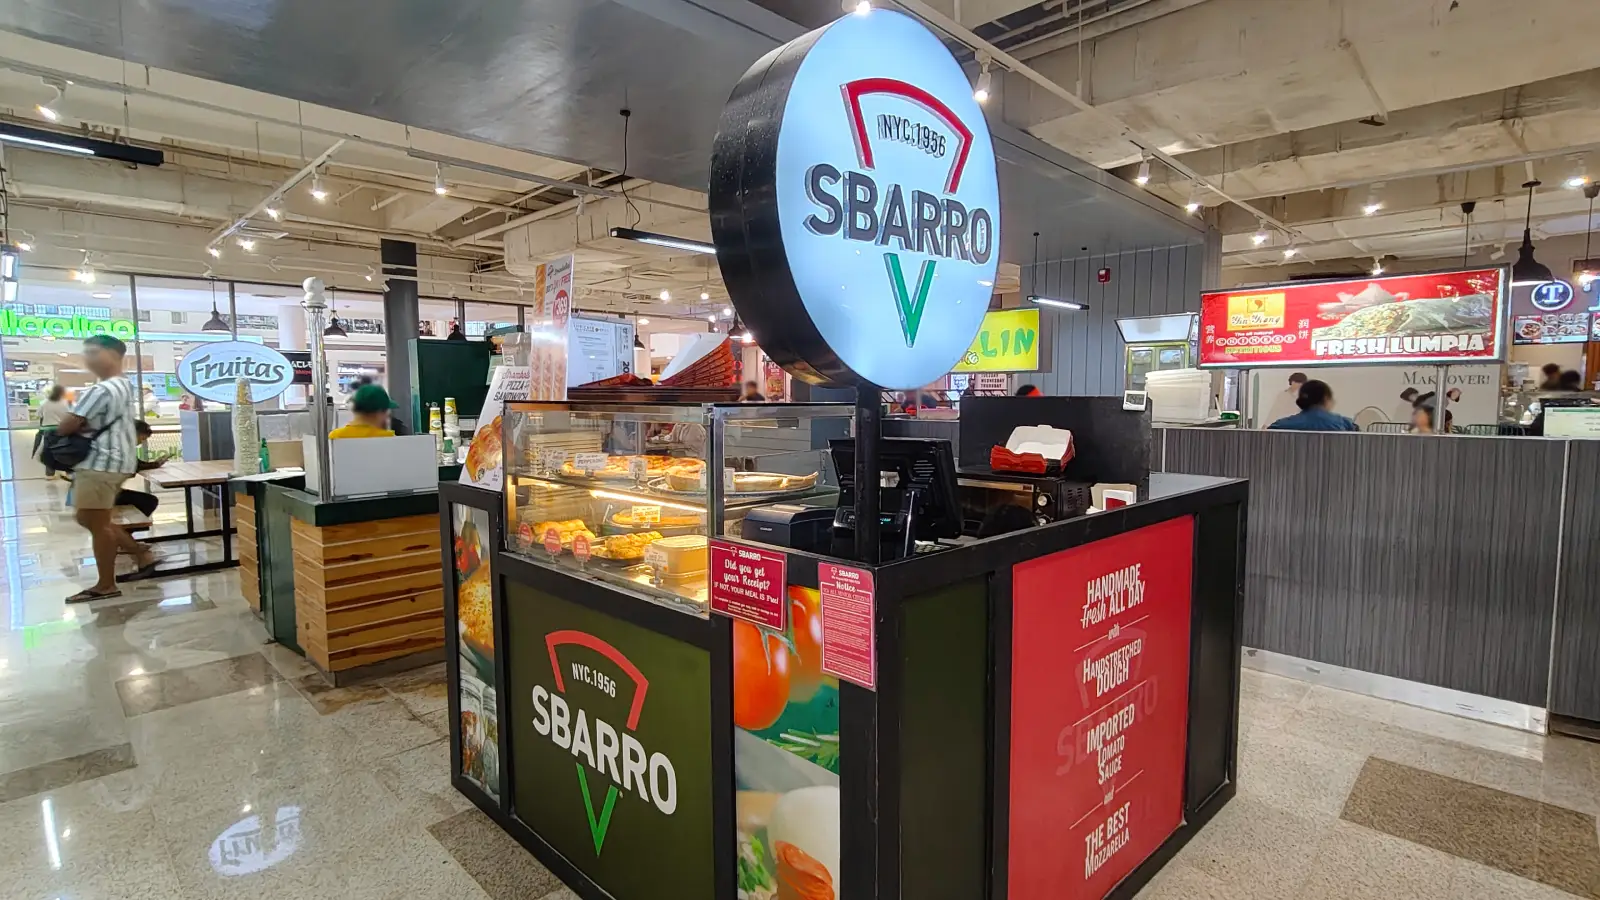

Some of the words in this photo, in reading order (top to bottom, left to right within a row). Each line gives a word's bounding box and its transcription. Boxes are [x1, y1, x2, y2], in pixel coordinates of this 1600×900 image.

[803, 163, 992, 265] SBARRO
[1541, 285, 1563, 304] T
[1316, 337, 1387, 356] FRESH
[1391, 334, 1485, 353] LUMPIA
[190, 353, 285, 387] Fruitas
[1402, 371, 1490, 385] MAKOVER!
[724, 558, 737, 570] Did
[738, 563, 752, 575] you
[754, 567, 765, 578] get
[738, 549, 761, 562] SBARRO
[723, 572, 739, 583] your
[742, 575, 771, 591] Receipt?
[836, 581, 857, 593] Notice
[838, 569, 859, 580] SBARRO
[1087, 563, 1141, 605] HANDMADE
[730, 585, 744, 594] YOUR
[744, 589, 758, 599] MEAL
[760, 593, 765, 601] IS
[1109, 590, 1125, 617] ALL
[1128, 580, 1146, 609] DAY
[1083, 638, 1142, 684] HANDSTRETCHED
[1096, 658, 1129, 697] DOUGH
[571, 662, 617, 698] NYC.1956
[1086, 703, 1135, 754] IMPORTED
[532, 684, 677, 815] SBARRO
[1097, 734, 1125, 767] TOMATO
[1098, 755, 1122, 785] SAUCE
[1085, 823, 1104, 857] THE
[1106, 801, 1131, 840] BEST
[1085, 827, 1130, 880] MOZZARELLA
